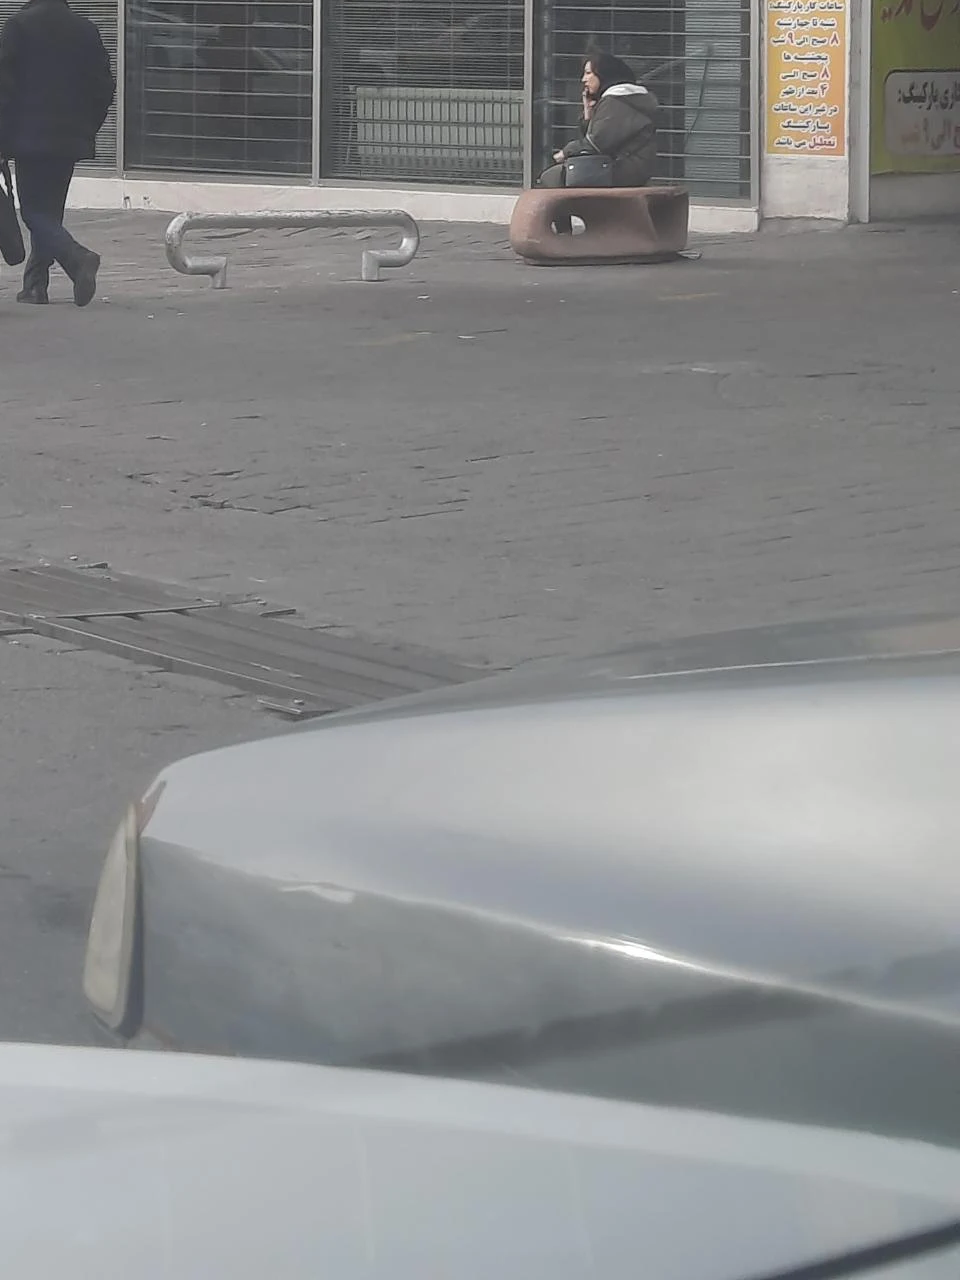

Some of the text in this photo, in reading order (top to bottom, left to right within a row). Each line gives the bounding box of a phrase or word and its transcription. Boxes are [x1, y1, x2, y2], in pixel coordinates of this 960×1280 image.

[804, 1, 816, 12] کار
[819, 1, 843, 10] ساعات
[812, 18, 818, 27] تا
[787, 32, 794, 44] ۹
[796, 36, 809, 46] الی
[811, 37, 827, 46] صبح
[830, 32, 839, 45] ۸
[783, 52, 792, 61] ها
[781, 66, 830, 80] ۸ صبح الی
[820, 83, 828, 96] ۴
[773, 103, 838, 115] در غیر این ساعات
[781, 119, 830, 133] پارکینگ
[808, 136, 836, 149] تعطیل
